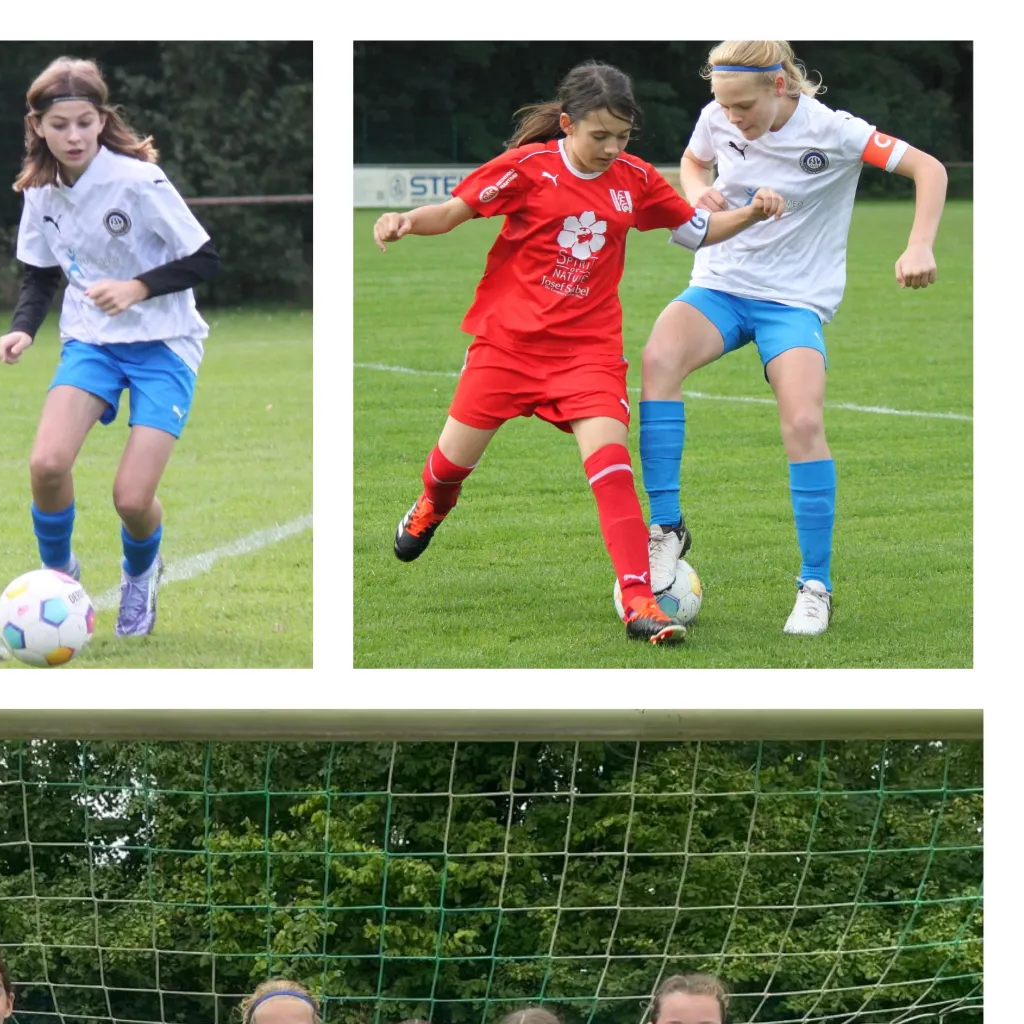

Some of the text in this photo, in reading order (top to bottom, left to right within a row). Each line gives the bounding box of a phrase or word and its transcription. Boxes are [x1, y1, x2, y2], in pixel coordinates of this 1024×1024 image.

[874, 134, 891, 148] C
[410, 176, 463, 196] STE
[540, 275, 566, 292] Josef
